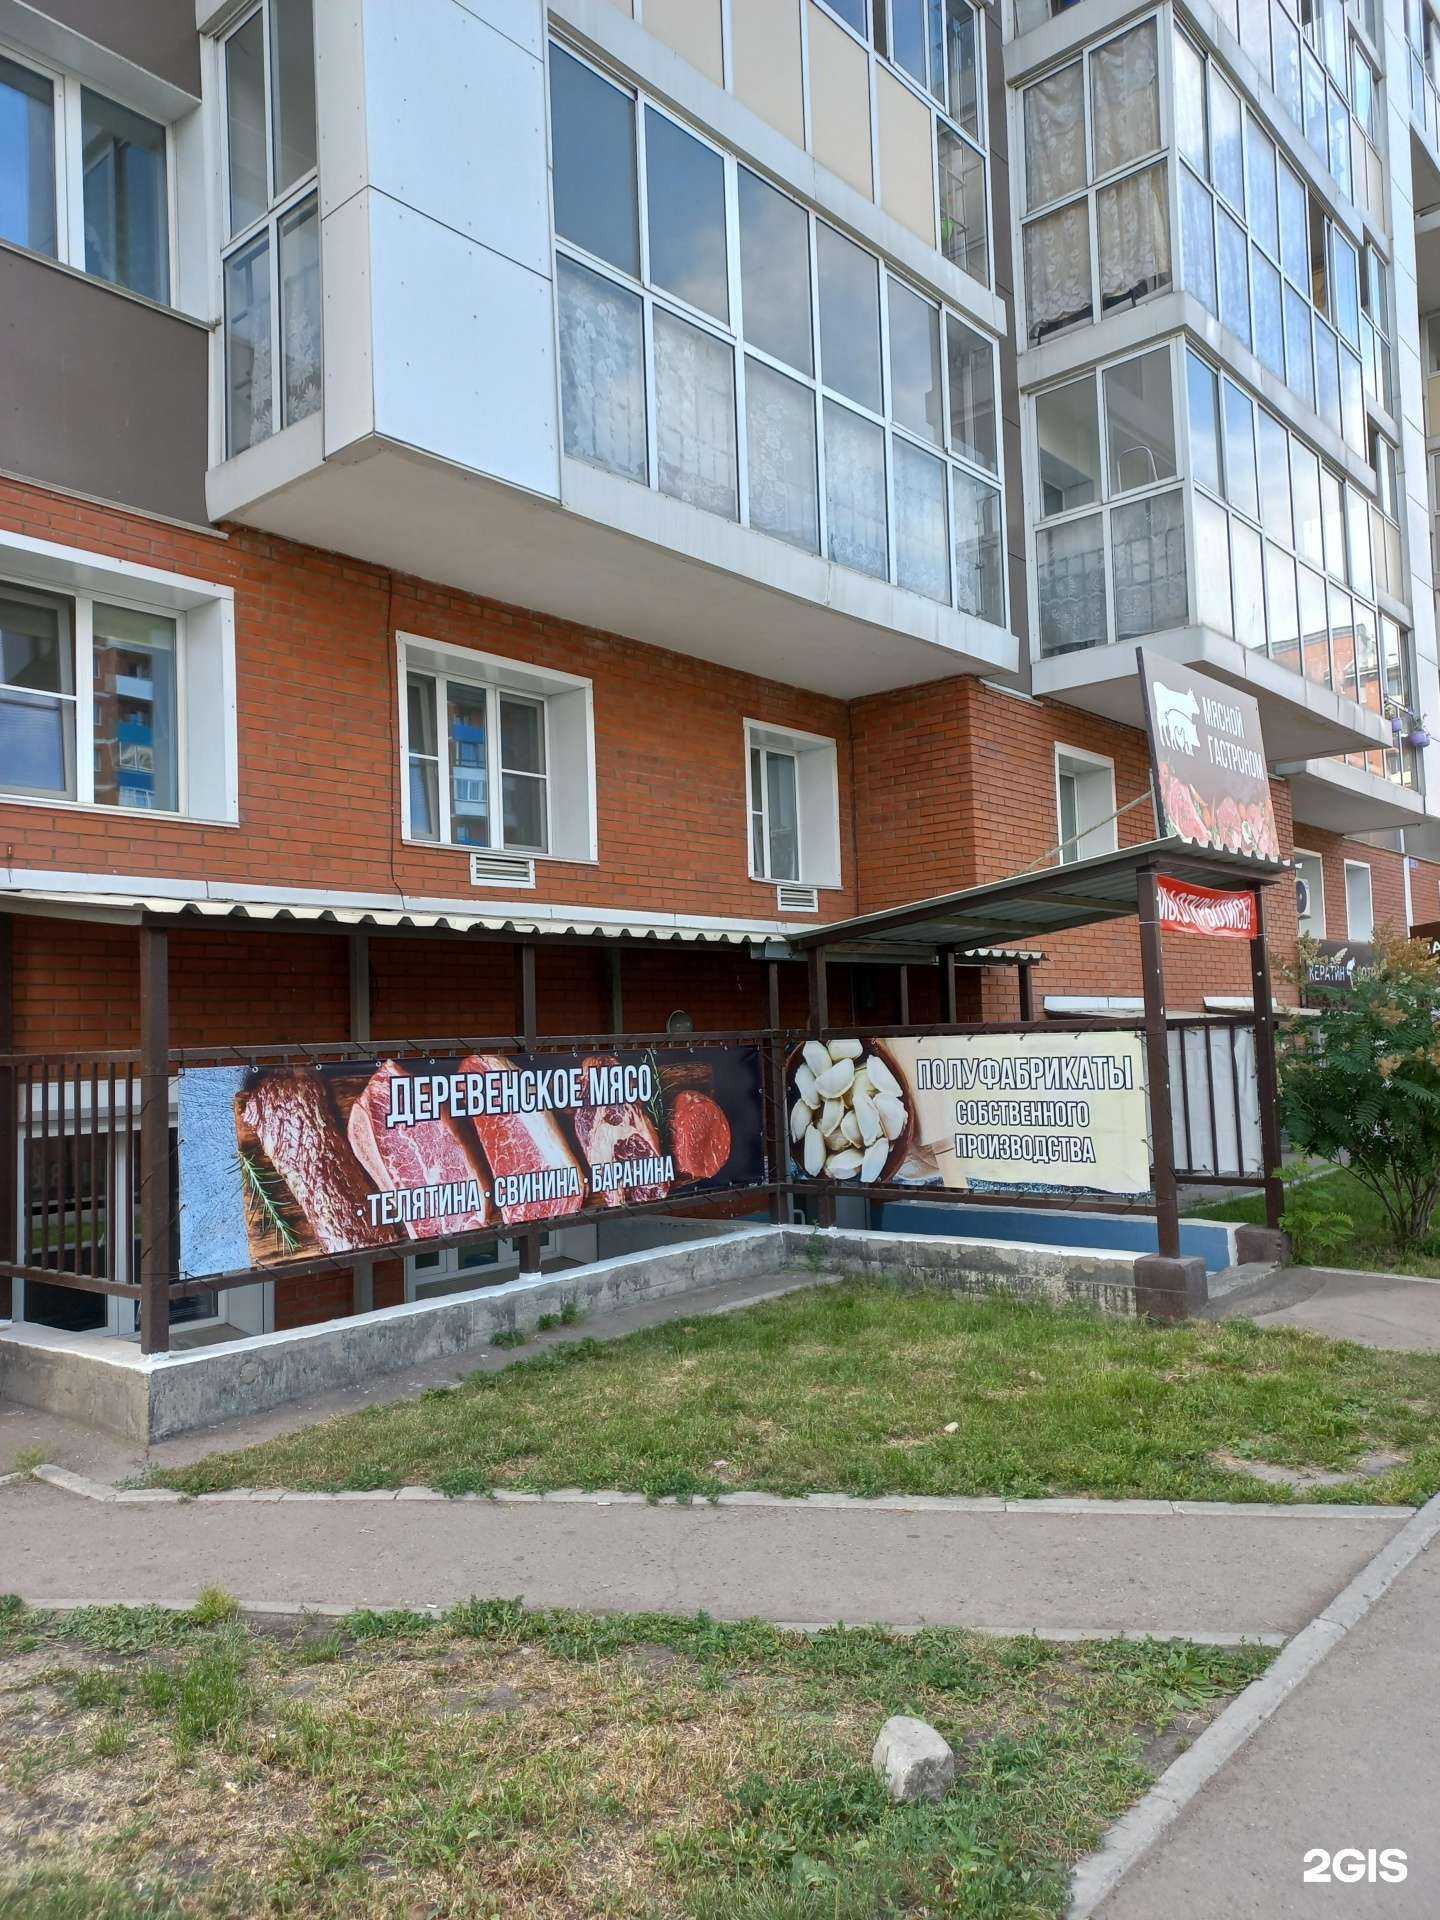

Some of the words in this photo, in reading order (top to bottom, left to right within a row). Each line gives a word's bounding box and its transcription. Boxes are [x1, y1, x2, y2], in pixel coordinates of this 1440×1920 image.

[1202, 696, 1245, 739] МЯСНОЙ
[1207, 734, 1265, 781] ГАСТРОНОМ
[917, 1056, 1133, 1090] ПОЛУФАБРИКАТЫ
[386, 1066, 584, 1129] ДЕРЕВЕНСКОЕ
[589, 1063, 652, 1106] МЯСО
[956, 1100, 1089, 1127] СОБСТВЕННОГО
[955, 1133, 1096, 1164] ПРОИЗВОДСТВА
[367, 1178, 482, 1227] ТЕЛЯТИНА
[494, 1167, 580, 1208] СВИНИНА
[591, 1155, 675, 1193] БАРАНИНА
